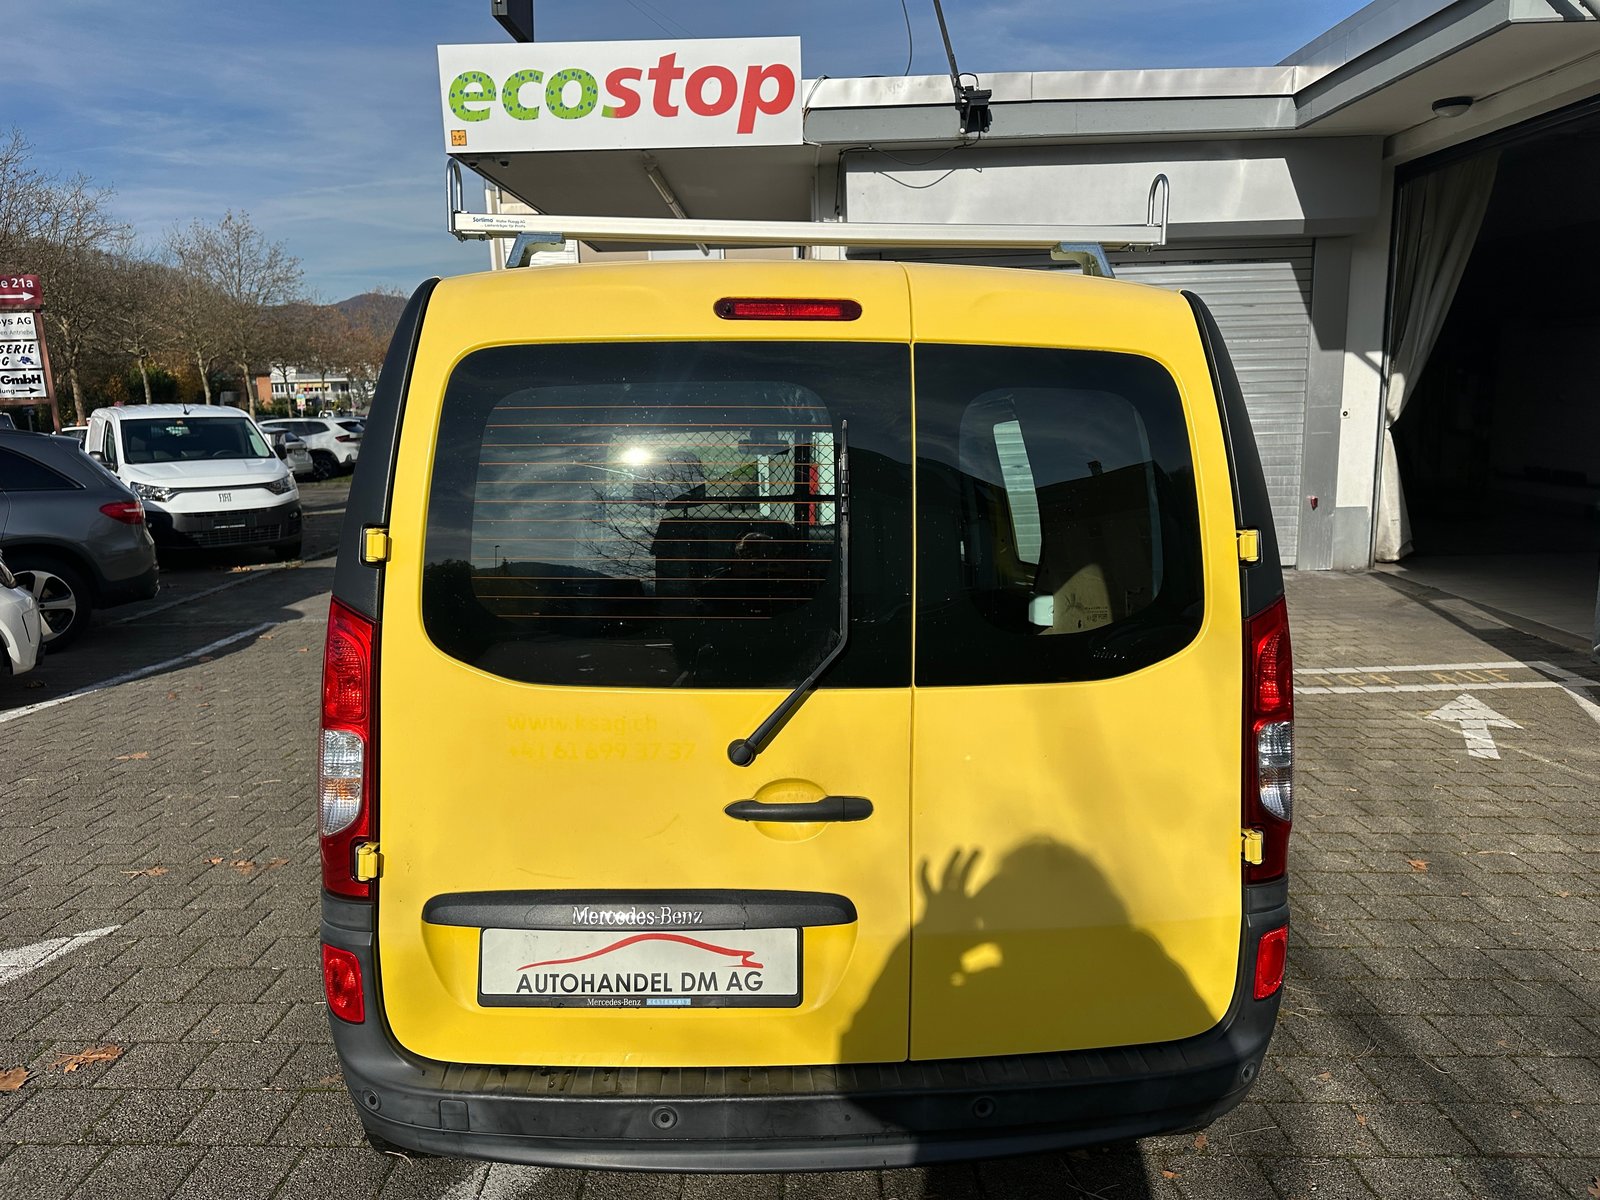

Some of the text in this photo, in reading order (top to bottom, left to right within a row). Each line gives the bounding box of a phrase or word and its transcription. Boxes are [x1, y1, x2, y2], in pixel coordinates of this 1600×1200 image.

[448, 52, 796, 134] ecostop
[0, 277, 34, 289] e 21a
[0, 316, 32, 327] ys AG
[0, 343, 35, 355] SERIE
[0, 356, 10, 367] G
[0, 374, 42, 385] GmbH
[571, 905, 703, 927] Mercedes-Benz
[515, 971, 764, 994] AUTOHANDEL DM AG
[587, 998, 642, 1007] Mercedes-Benz
